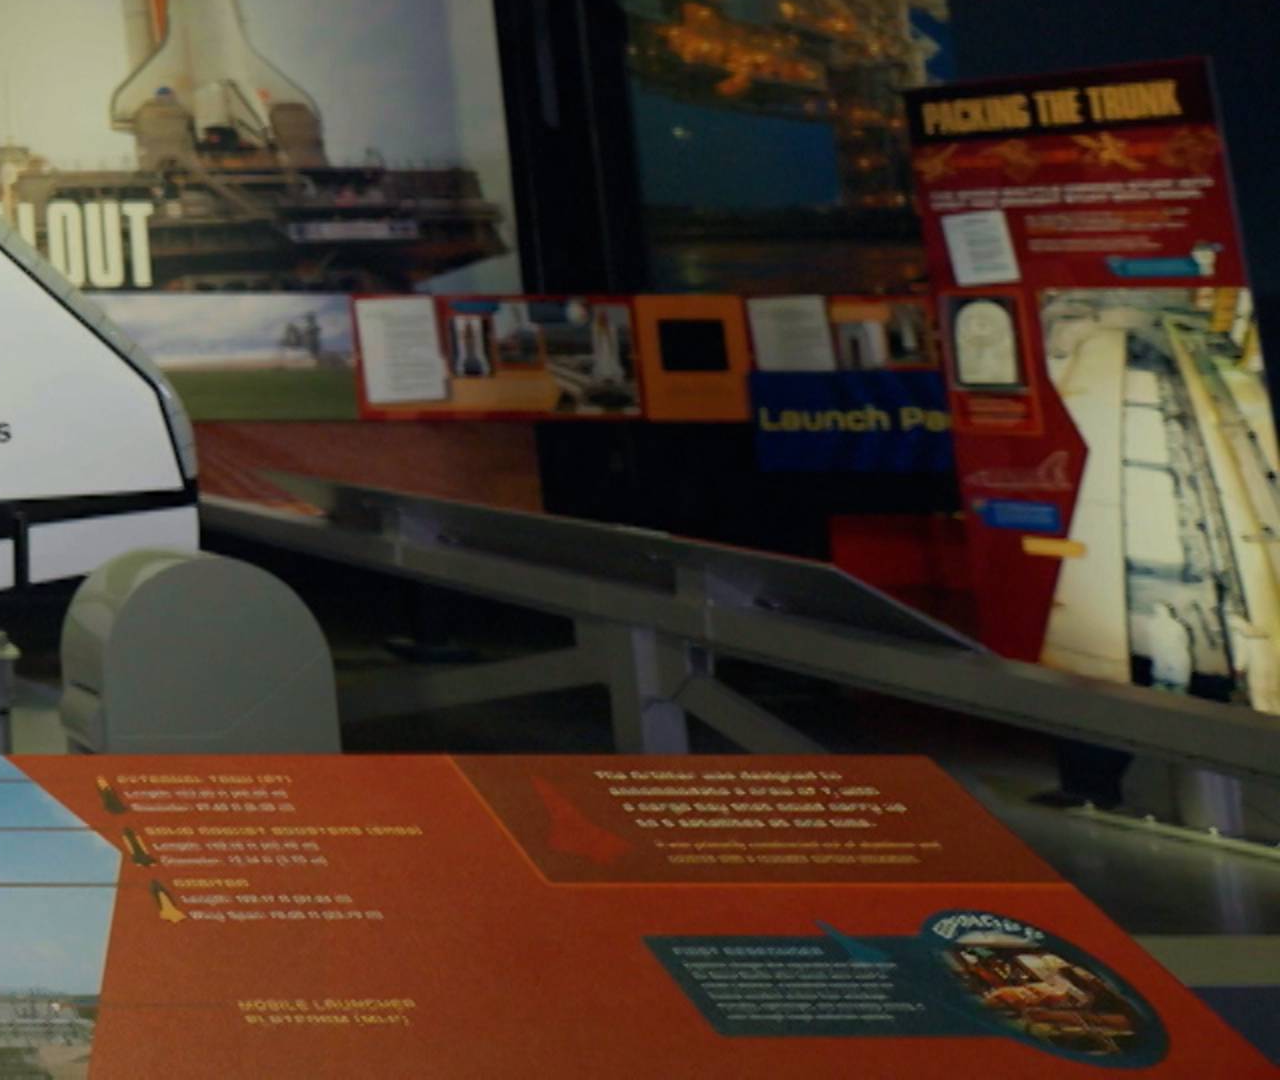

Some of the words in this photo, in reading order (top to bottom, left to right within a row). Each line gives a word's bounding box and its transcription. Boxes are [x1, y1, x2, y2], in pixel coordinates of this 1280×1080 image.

[920, 92, 1034, 138] PACKING
[1032, 86, 1087, 130] THE
[1084, 77, 1184, 123] TRUNK
[758, 403, 891, 433] Launch
[899, 405, 952, 433] Pa
